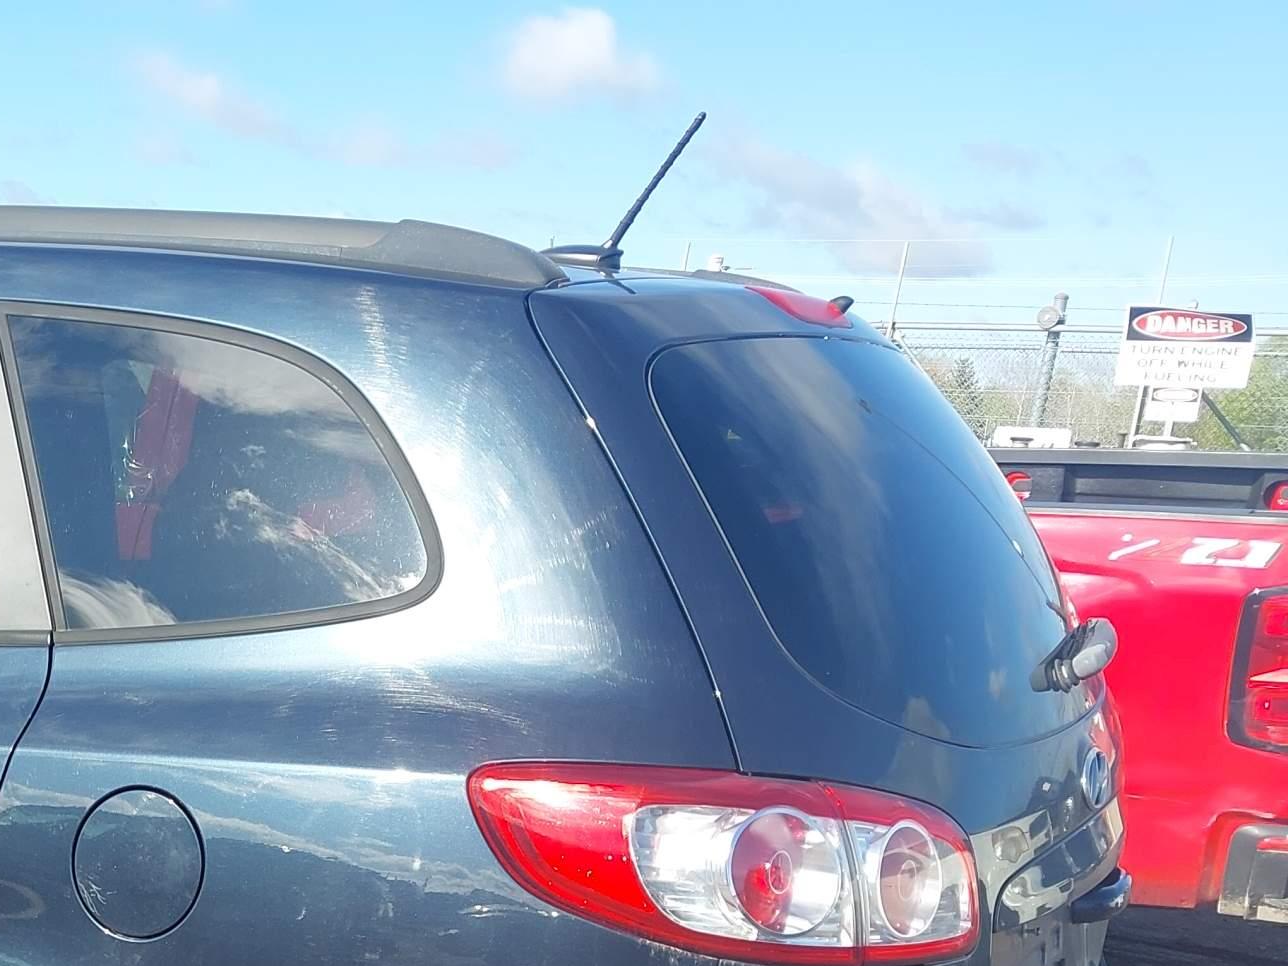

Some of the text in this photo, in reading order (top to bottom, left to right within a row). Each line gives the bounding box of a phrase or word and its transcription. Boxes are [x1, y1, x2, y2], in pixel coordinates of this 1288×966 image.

[1146, 315, 1234, 334] DANGER
[1129, 344, 1241, 357] TURN ENGINE
[1136, 358, 1230, 370] OFF WHILE
[1143, 371, 1217, 383] FUELING
